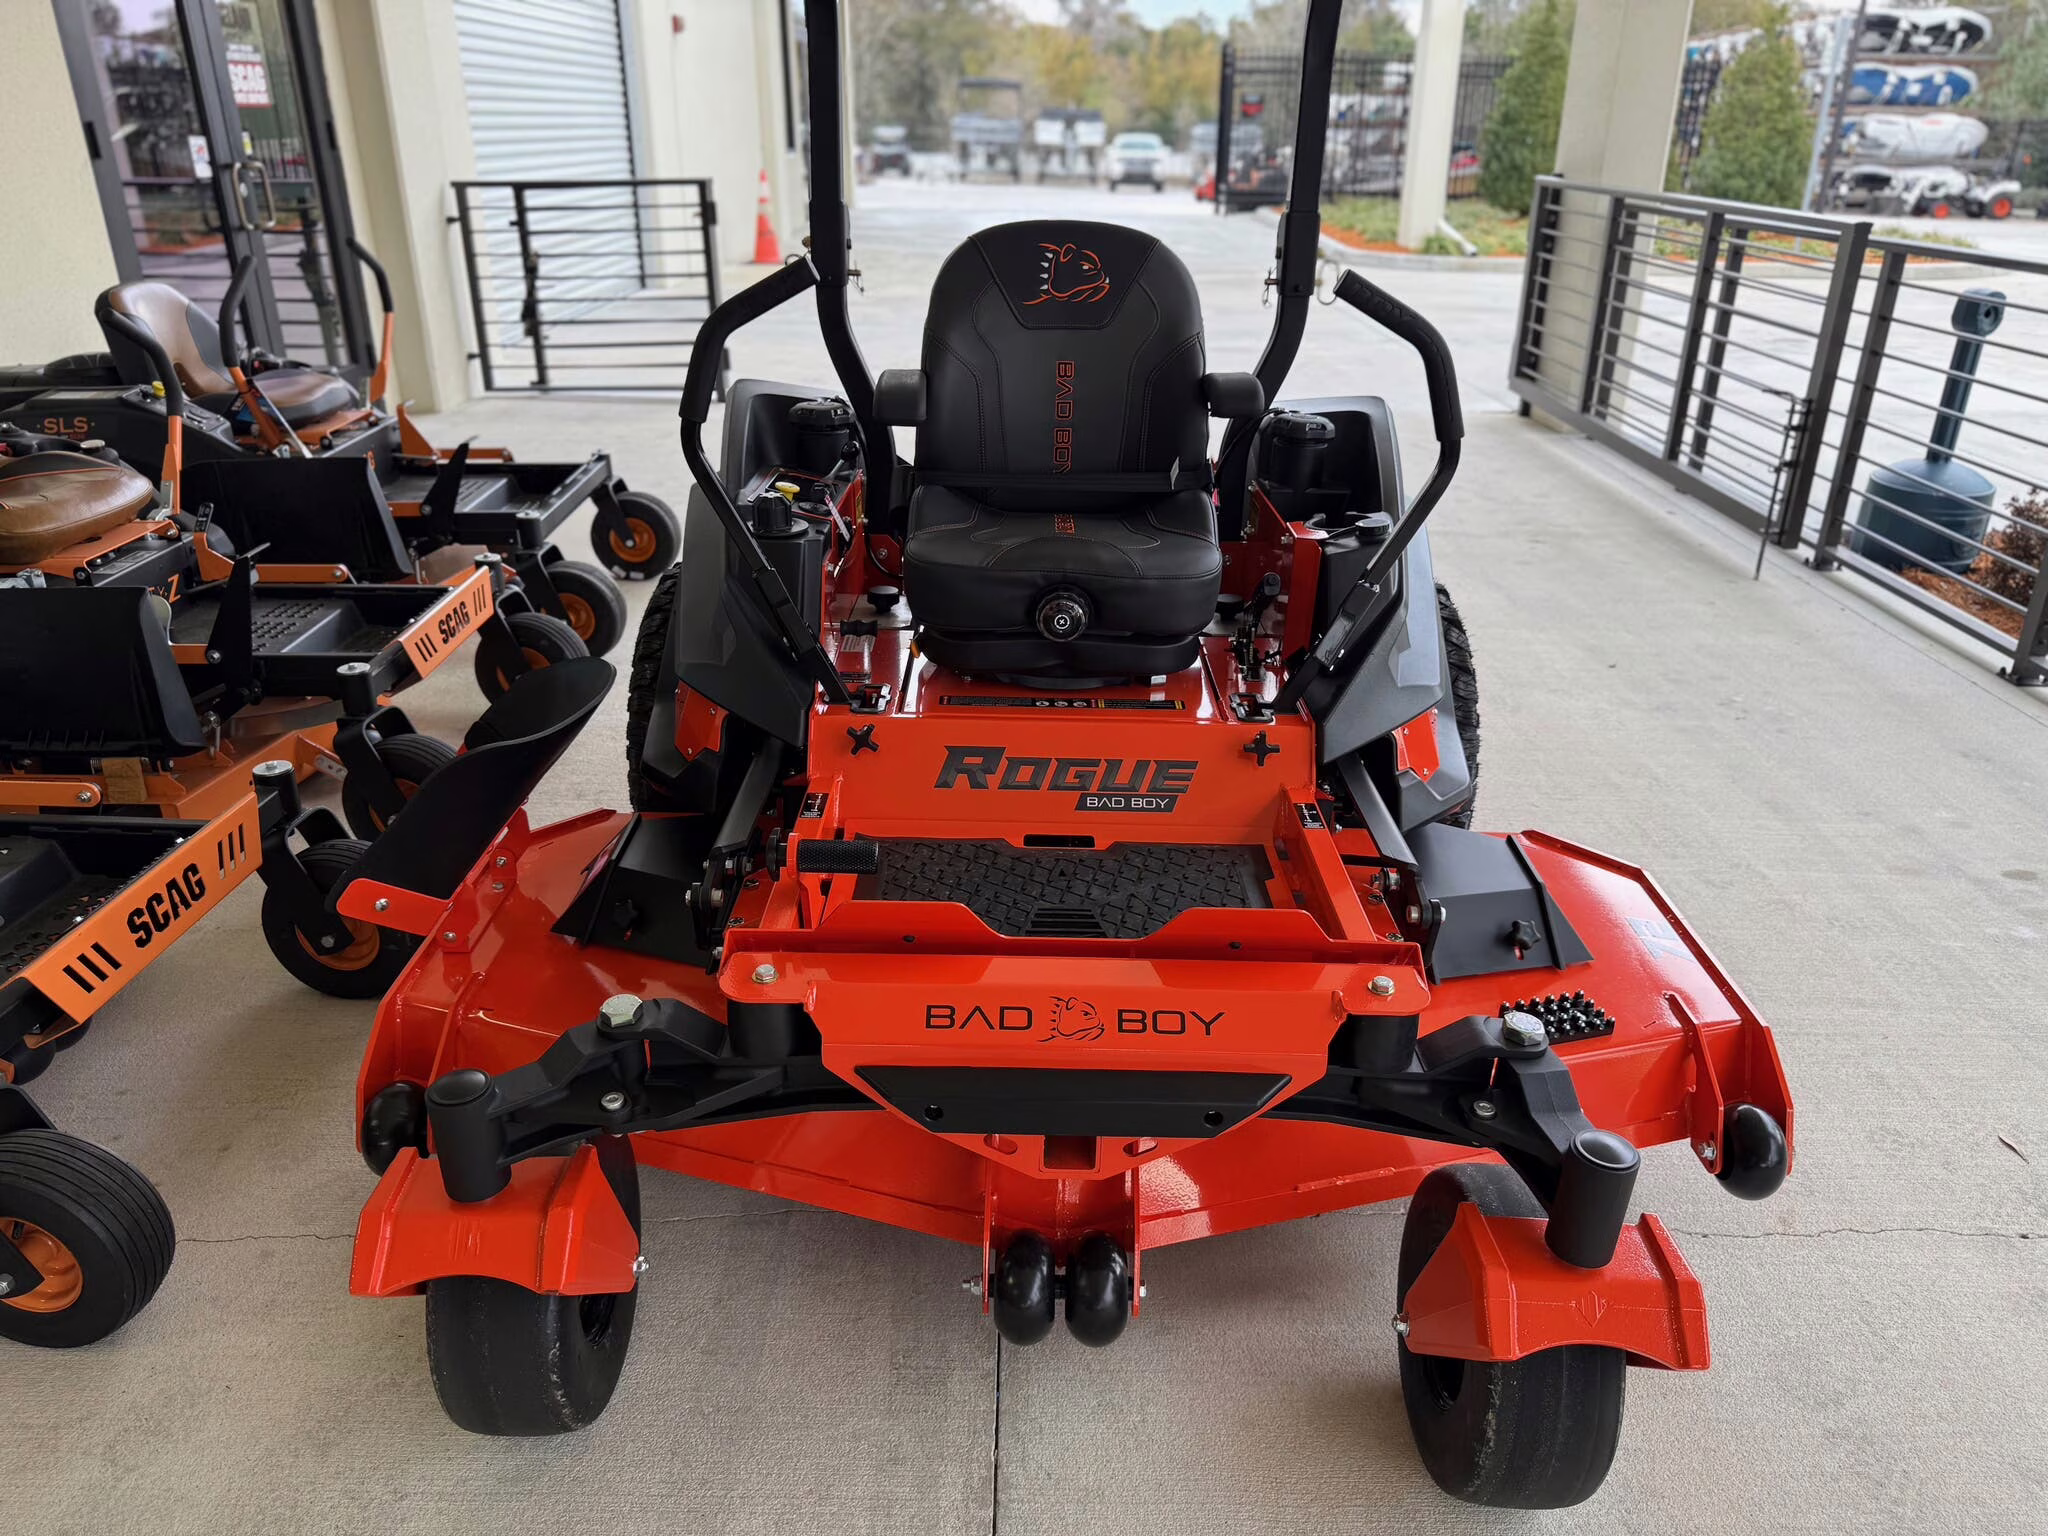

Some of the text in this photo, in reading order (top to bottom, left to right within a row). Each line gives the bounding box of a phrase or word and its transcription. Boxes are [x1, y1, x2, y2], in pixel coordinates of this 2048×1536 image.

[1056, 360, 1075, 421] BAD
[43, 416, 88, 434] SLS
[438, 600, 471, 645] SCAG
[934, 746, 1199, 794] ROGUE
[1086, 796, 1169, 809] BAD BOY
[127, 862, 206, 949] SCAG
[925, 1004, 1226, 1036] BAD BOY
